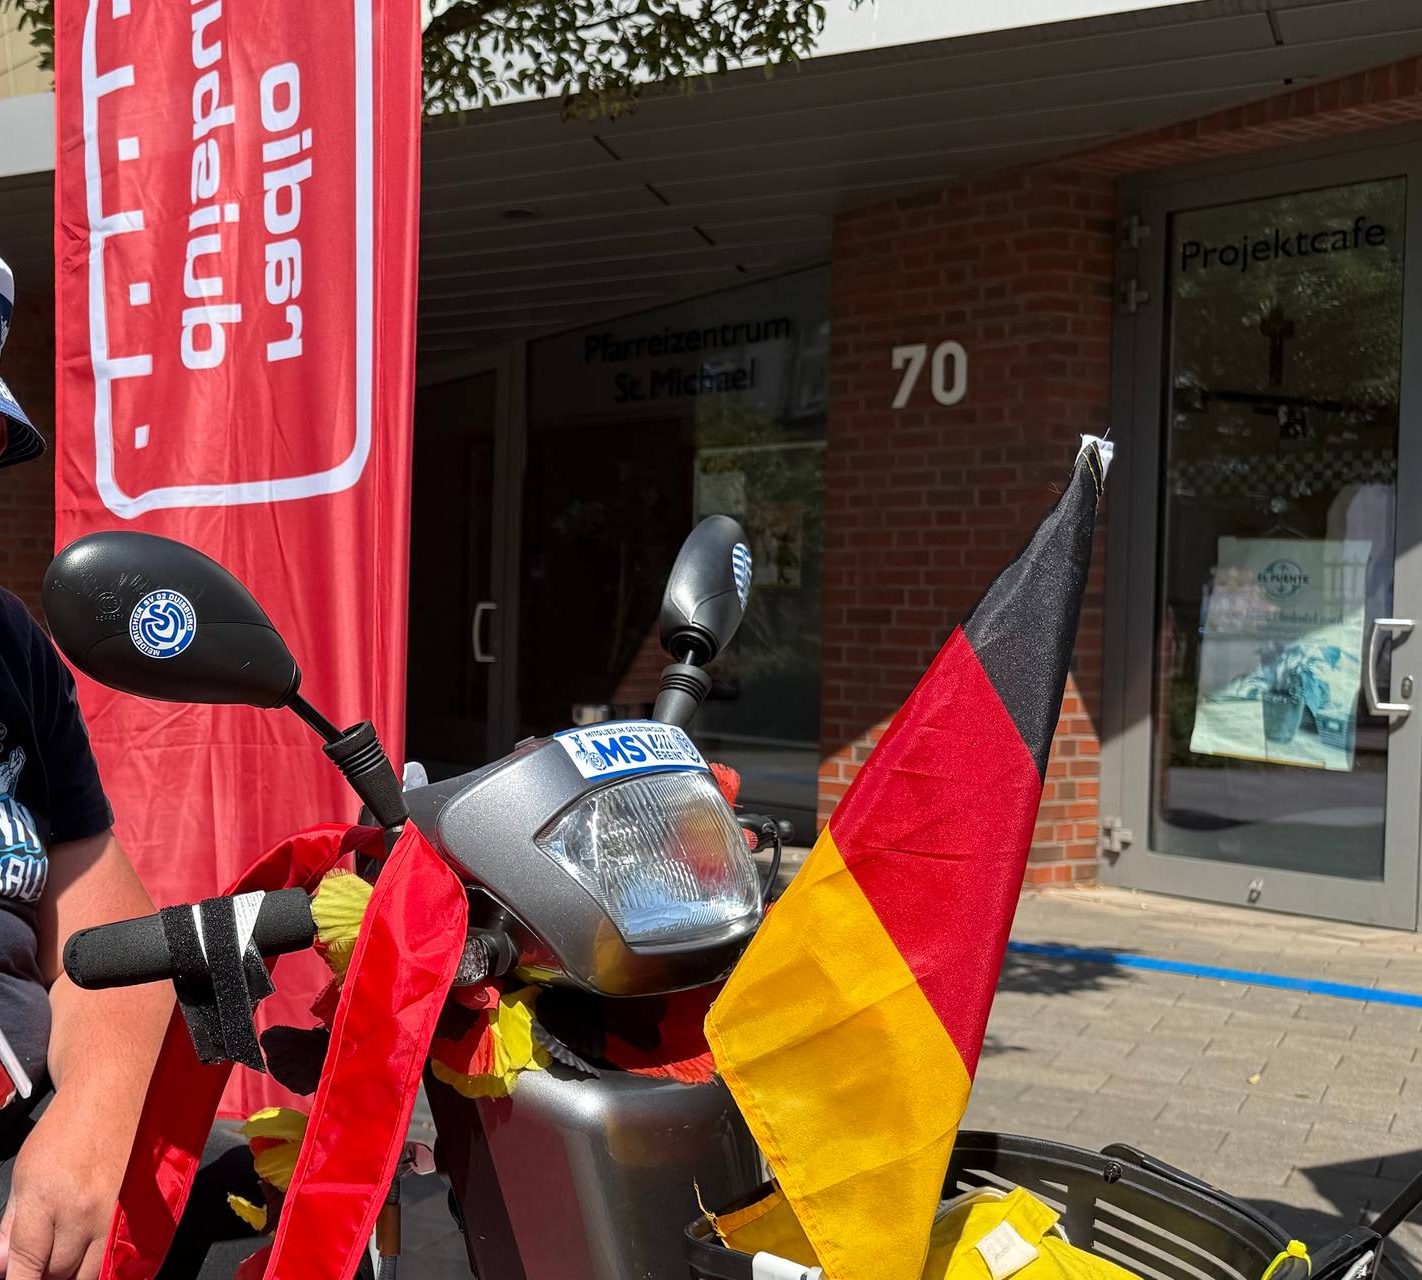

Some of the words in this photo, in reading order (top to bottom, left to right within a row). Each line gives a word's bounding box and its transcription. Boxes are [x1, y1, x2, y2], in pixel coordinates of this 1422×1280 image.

[1182, 216, 1386, 272] Projektcafe
[583, 315, 794, 365] Pfarreizentrum
[649, 357, 756, 399] Michael
[891, 340, 969, 409] 70
[1269, 573, 1310, 585] PUENTE
[156, 592, 167, 600] 02
[168, 593, 194, 632] DUISBURG
